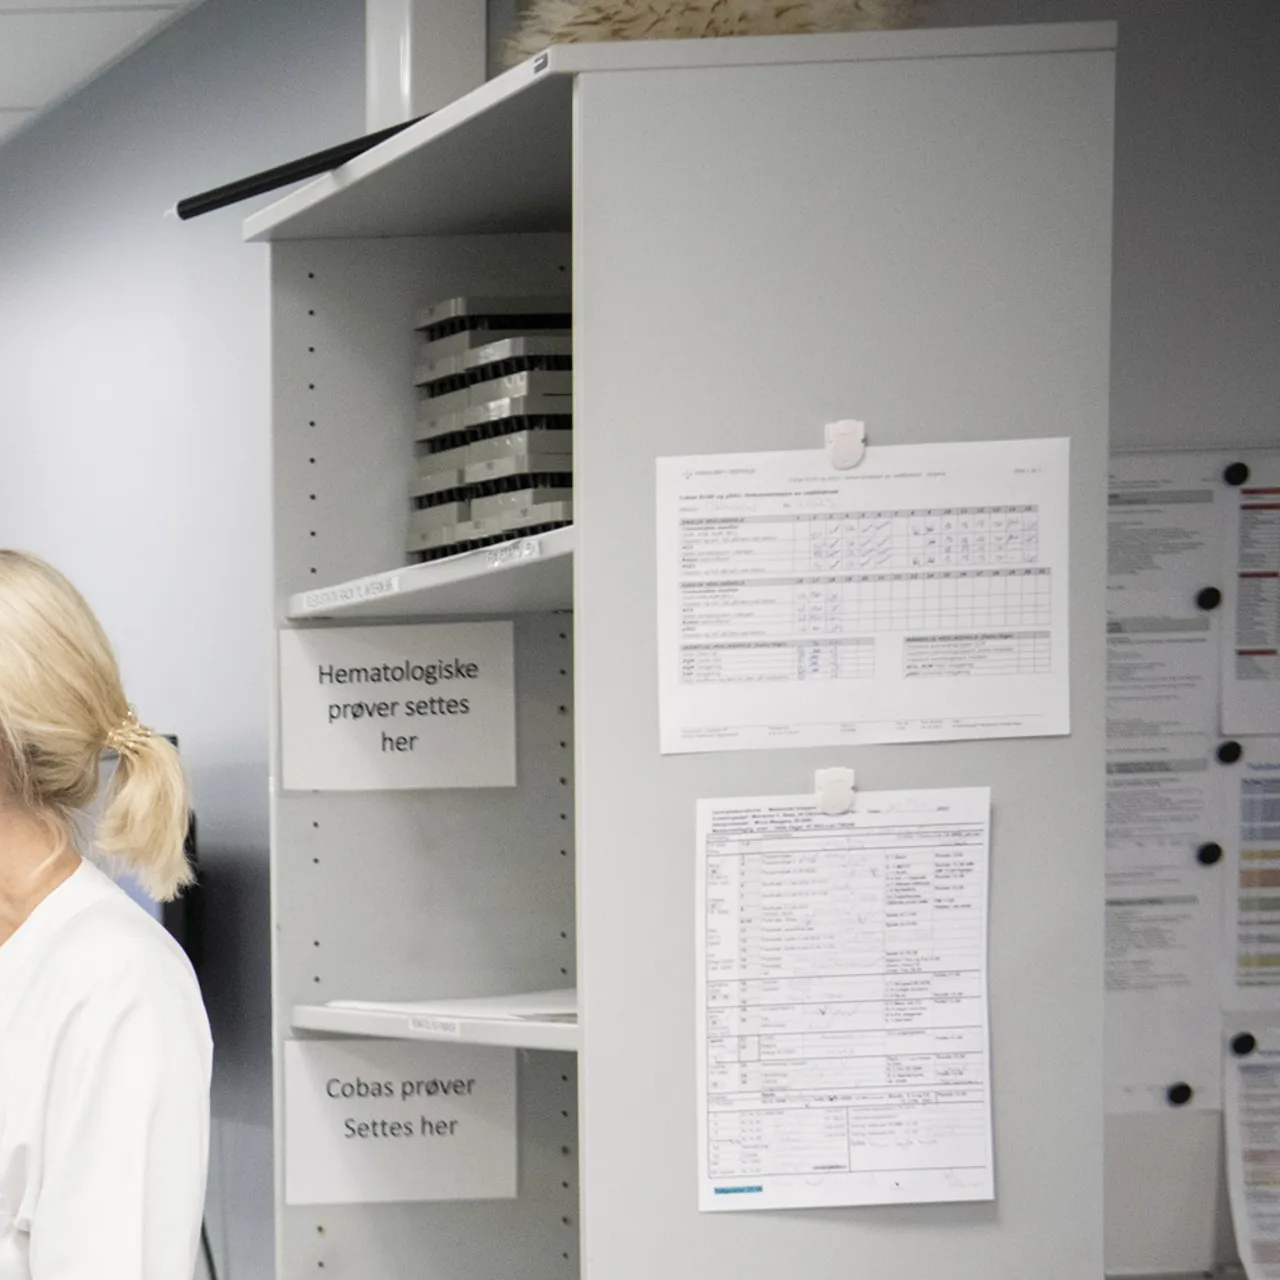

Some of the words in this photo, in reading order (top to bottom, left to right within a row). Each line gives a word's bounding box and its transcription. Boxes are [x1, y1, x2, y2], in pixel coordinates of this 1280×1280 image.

[318, 657, 479, 686] Hematologiske
[328, 701, 399, 723] prøver
[404, 696, 470, 717] settes
[381, 731, 419, 753] her
[326, 1077, 394, 1099] Cobas
[401, 1078, 476, 1101] prøver
[344, 1118, 414, 1138] Settes
[420, 1116, 459, 1137] her
